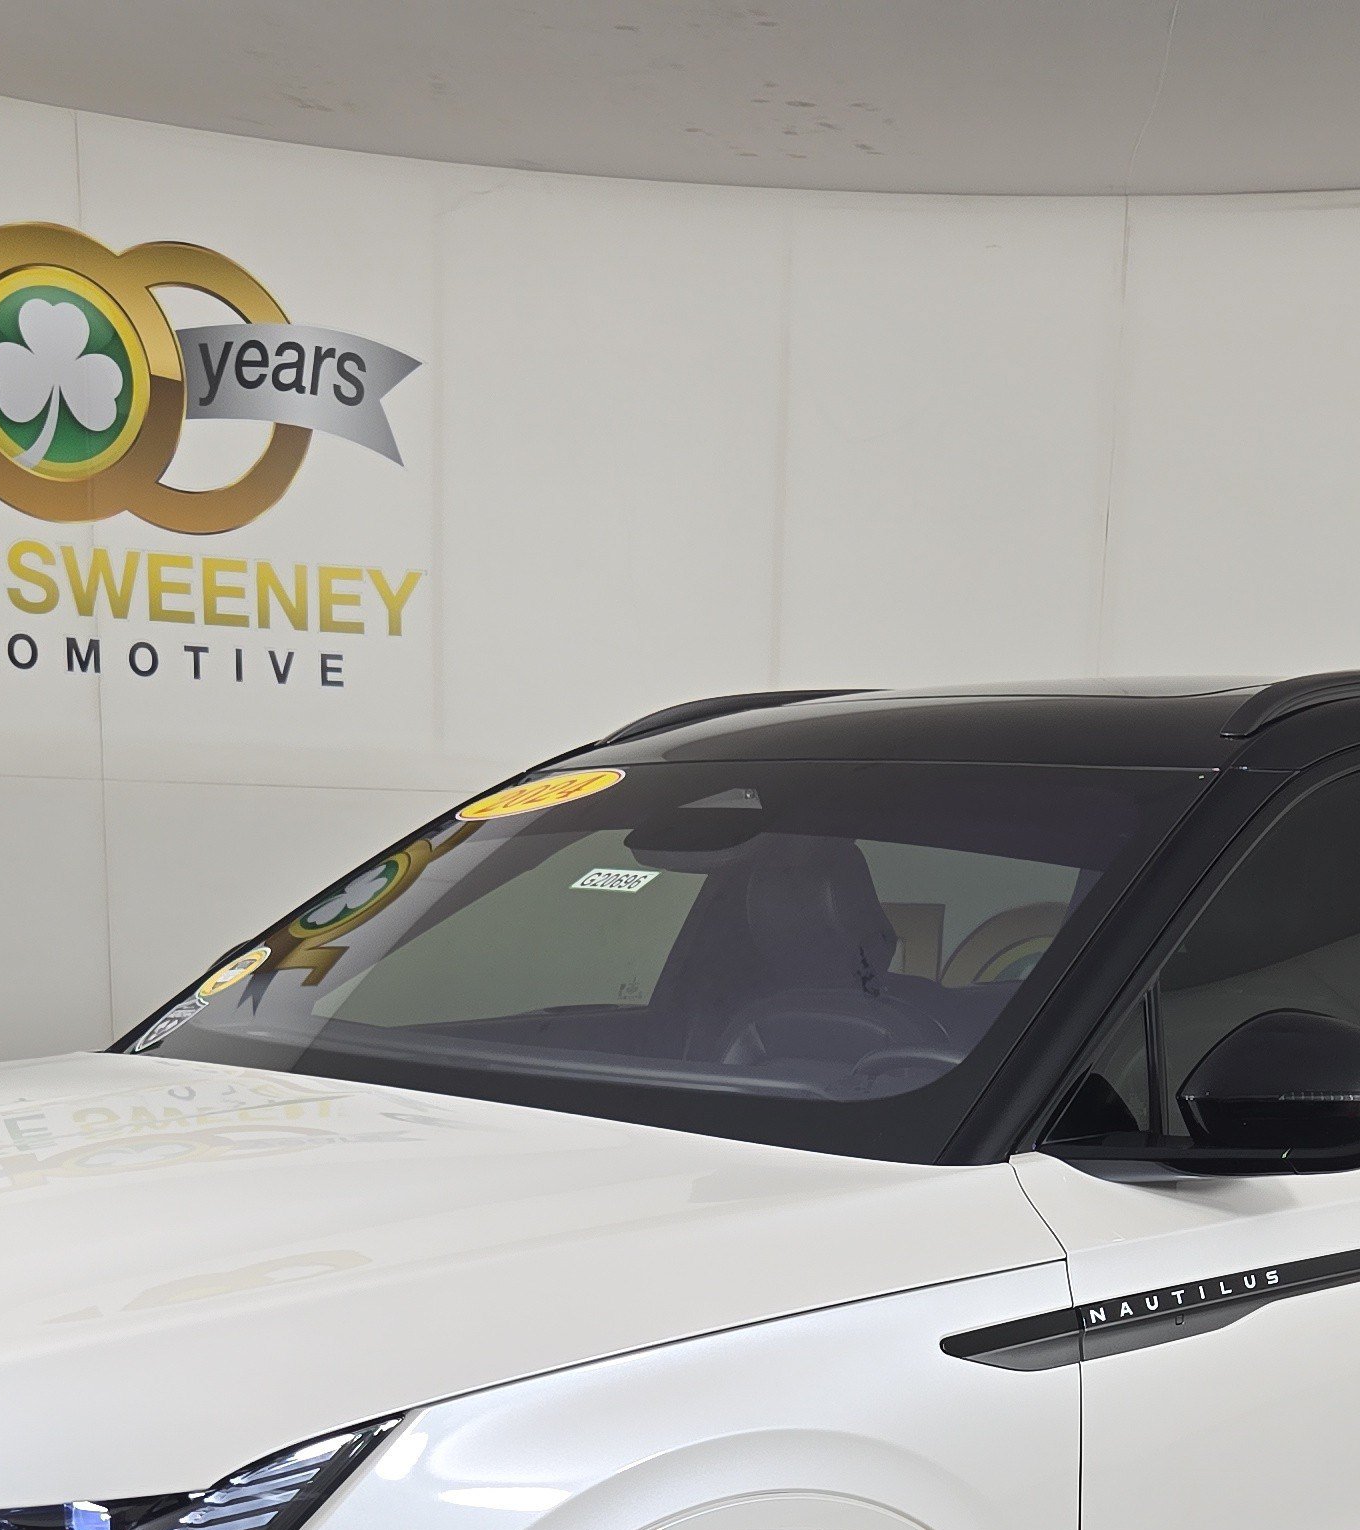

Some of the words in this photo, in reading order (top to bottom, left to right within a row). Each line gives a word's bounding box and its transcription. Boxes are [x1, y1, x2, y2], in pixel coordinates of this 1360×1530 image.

[198, 338, 367, 407] years
[6, 540, 423, 637] SWEENEY
[579, 872, 648, 890] G20696
[1089, 1269, 1280, 1325] NAUTILUS
